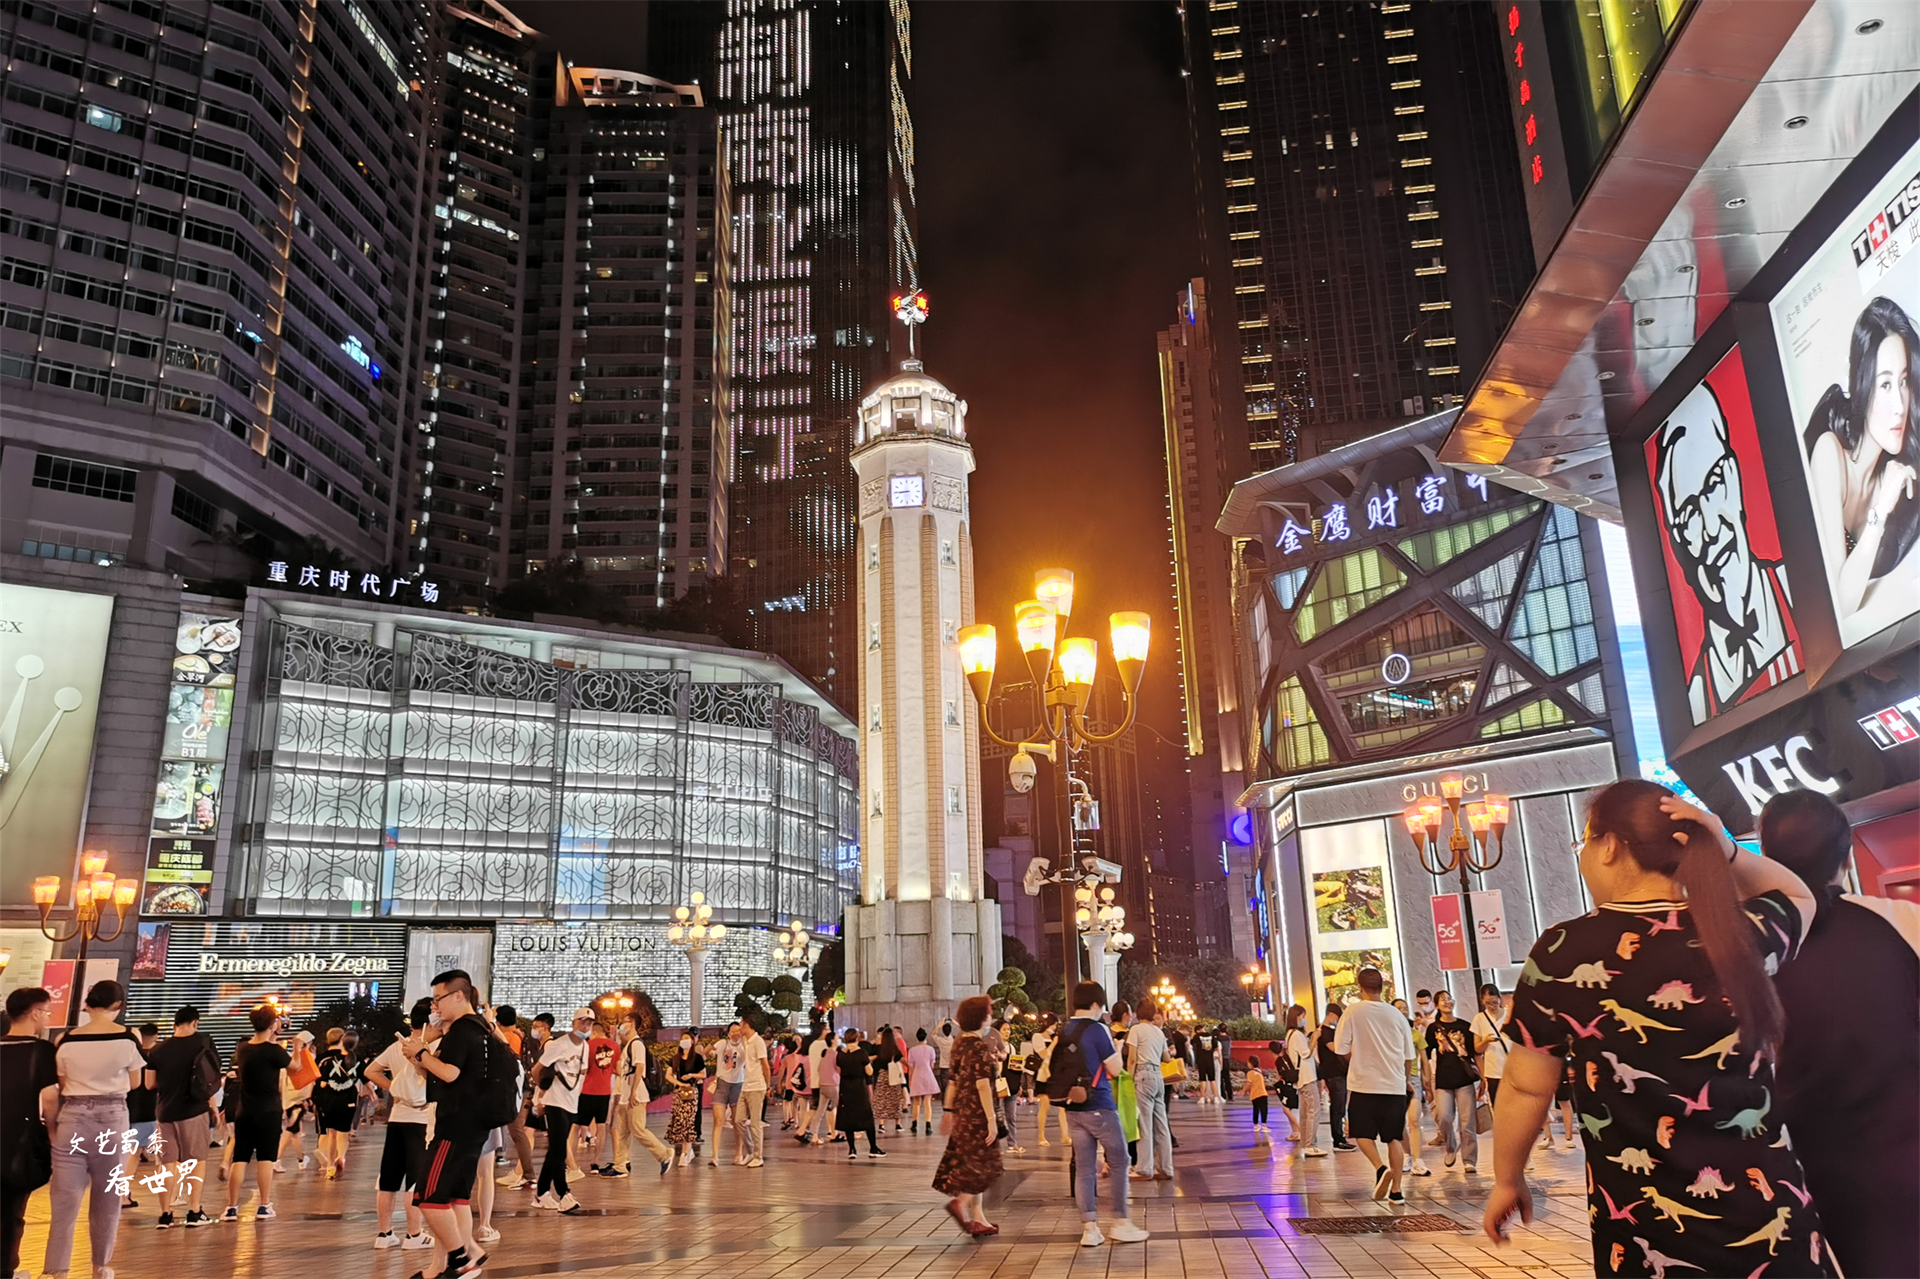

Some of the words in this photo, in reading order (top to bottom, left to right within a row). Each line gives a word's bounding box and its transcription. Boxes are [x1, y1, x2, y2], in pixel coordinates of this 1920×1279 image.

[267, 560, 441, 604] 重庆时代广场
[181, 747, 208, 759] B1层
[1401, 772, 1490, 802] GUCI
[1721, 735, 1841, 817] KFC
[510, 933, 571, 952] LOUIS
[577, 934, 657, 952] VUITTON
[197, 952, 327, 977] Ermenegildo
[330, 952, 390, 977] Zegna
